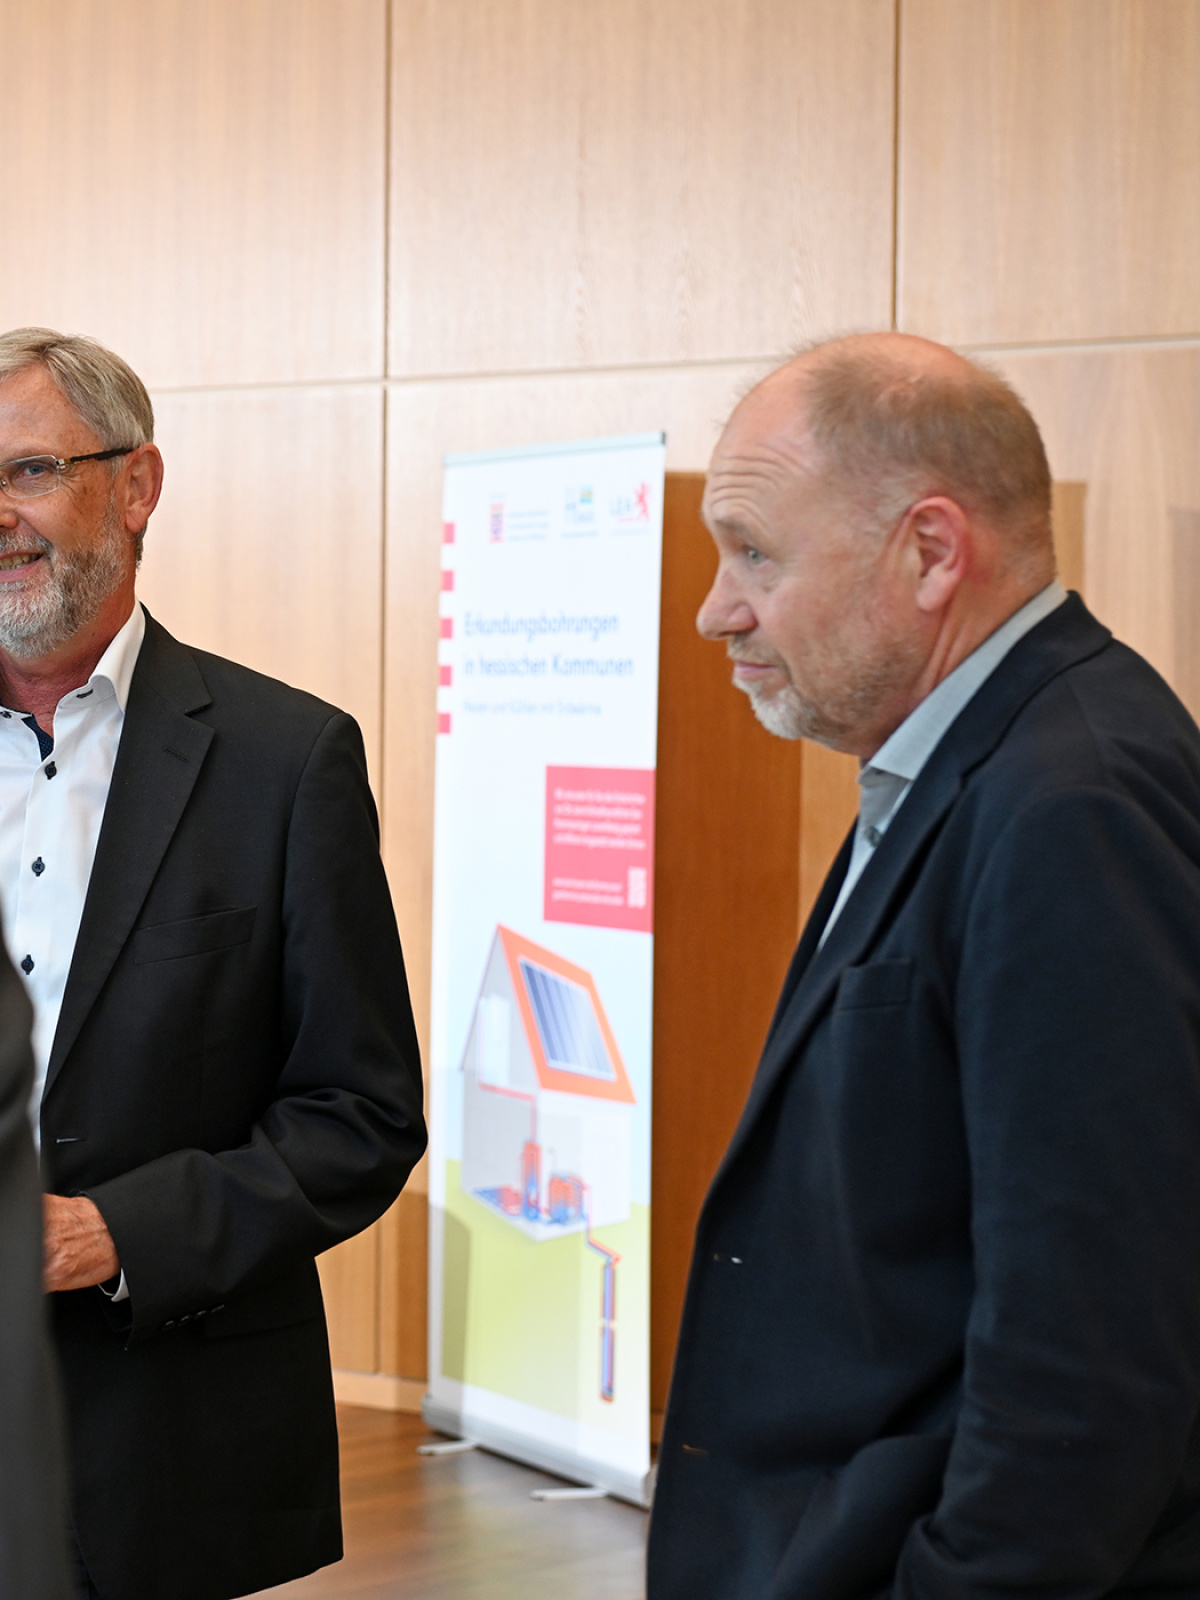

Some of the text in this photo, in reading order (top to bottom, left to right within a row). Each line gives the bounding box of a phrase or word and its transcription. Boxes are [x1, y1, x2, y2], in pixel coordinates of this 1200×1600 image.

[464, 608, 619, 642] Erkundungsbohrungen
[464, 652, 634, 676] in hessischen Kommunen
